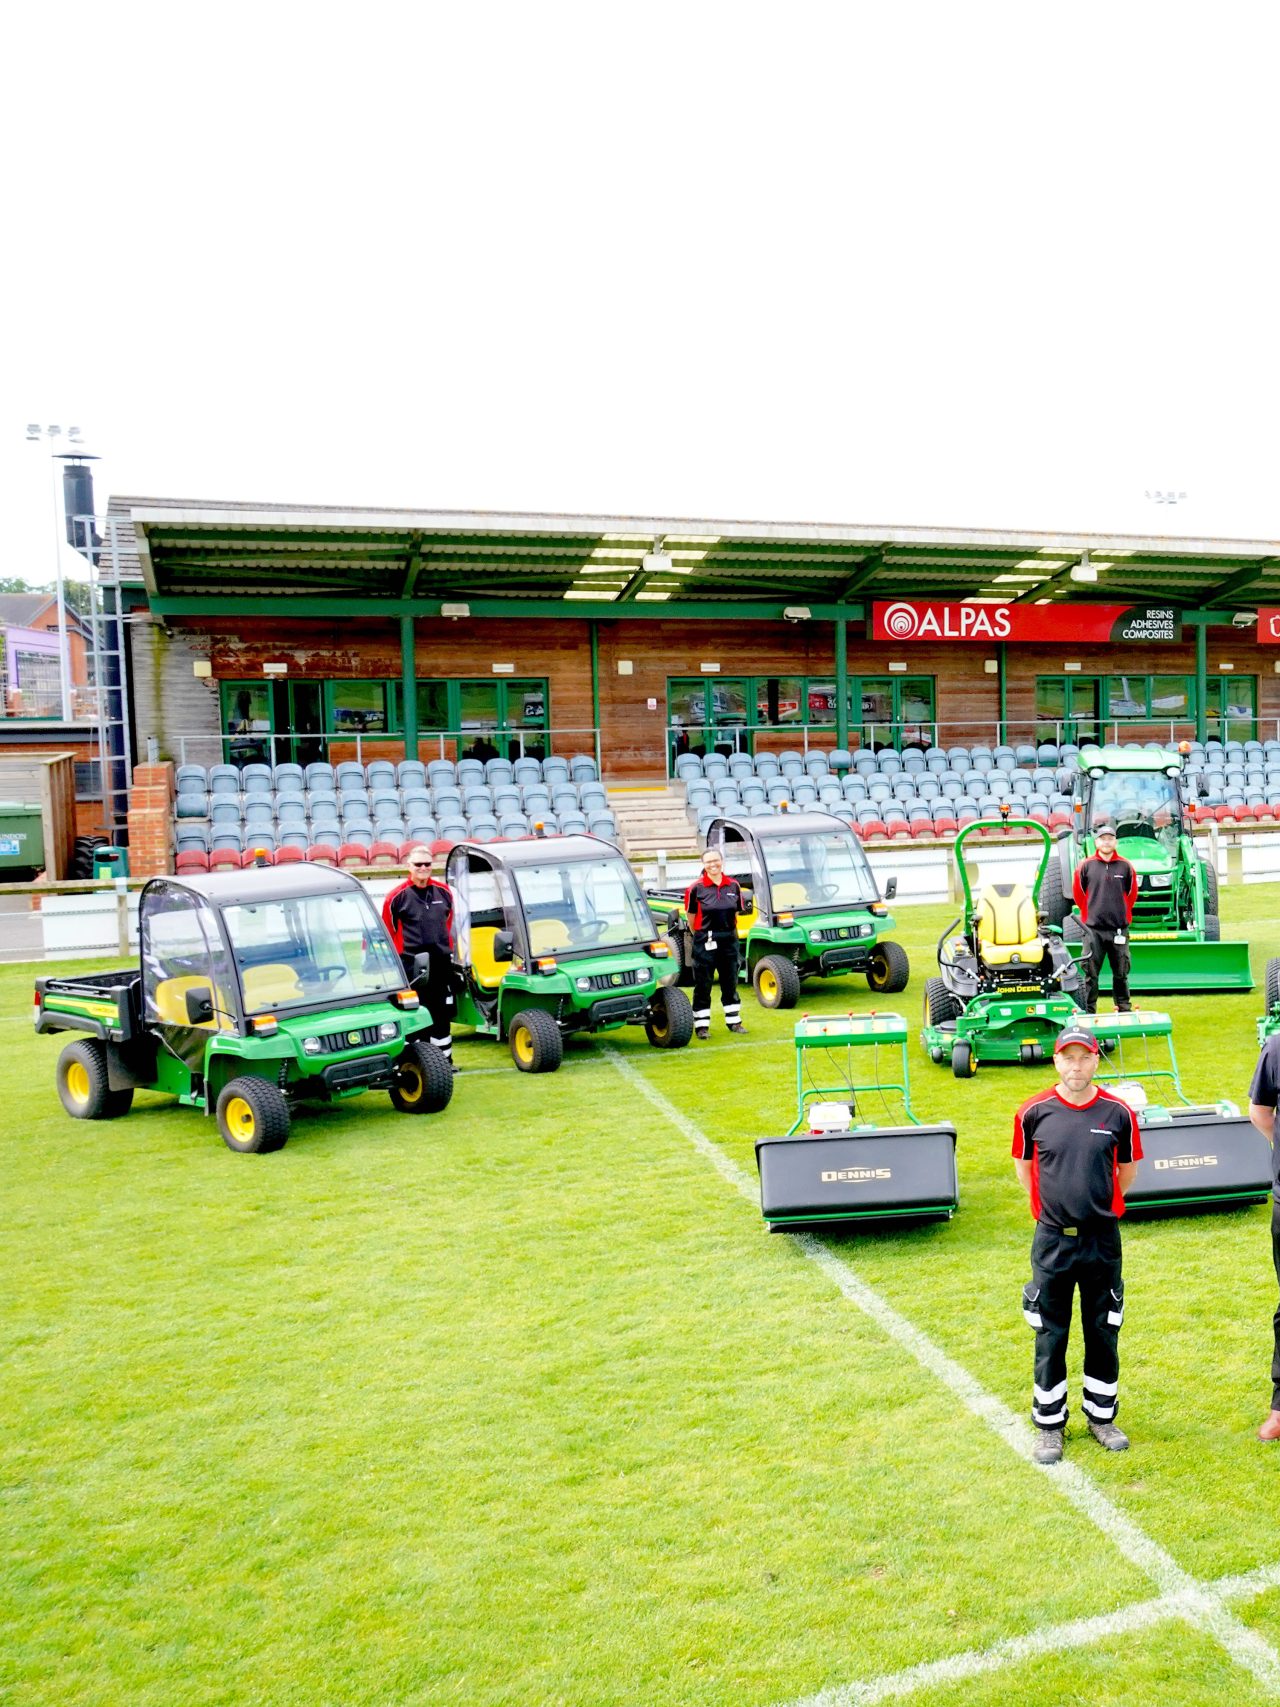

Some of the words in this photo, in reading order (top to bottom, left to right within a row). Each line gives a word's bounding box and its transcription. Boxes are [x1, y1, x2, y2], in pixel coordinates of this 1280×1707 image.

[1146, 609, 1174, 619] RESINS
[917, 607, 1011, 637] ALPAS
[1130, 620, 1174, 629] ADHESIVES
[1122, 629, 1174, 639] COMPOSITES
[996, 986, 1016, 994] JOHN
[1154, 1155, 1218, 1170] DENNIS
[821, 1168, 892, 1182] DENNIS
